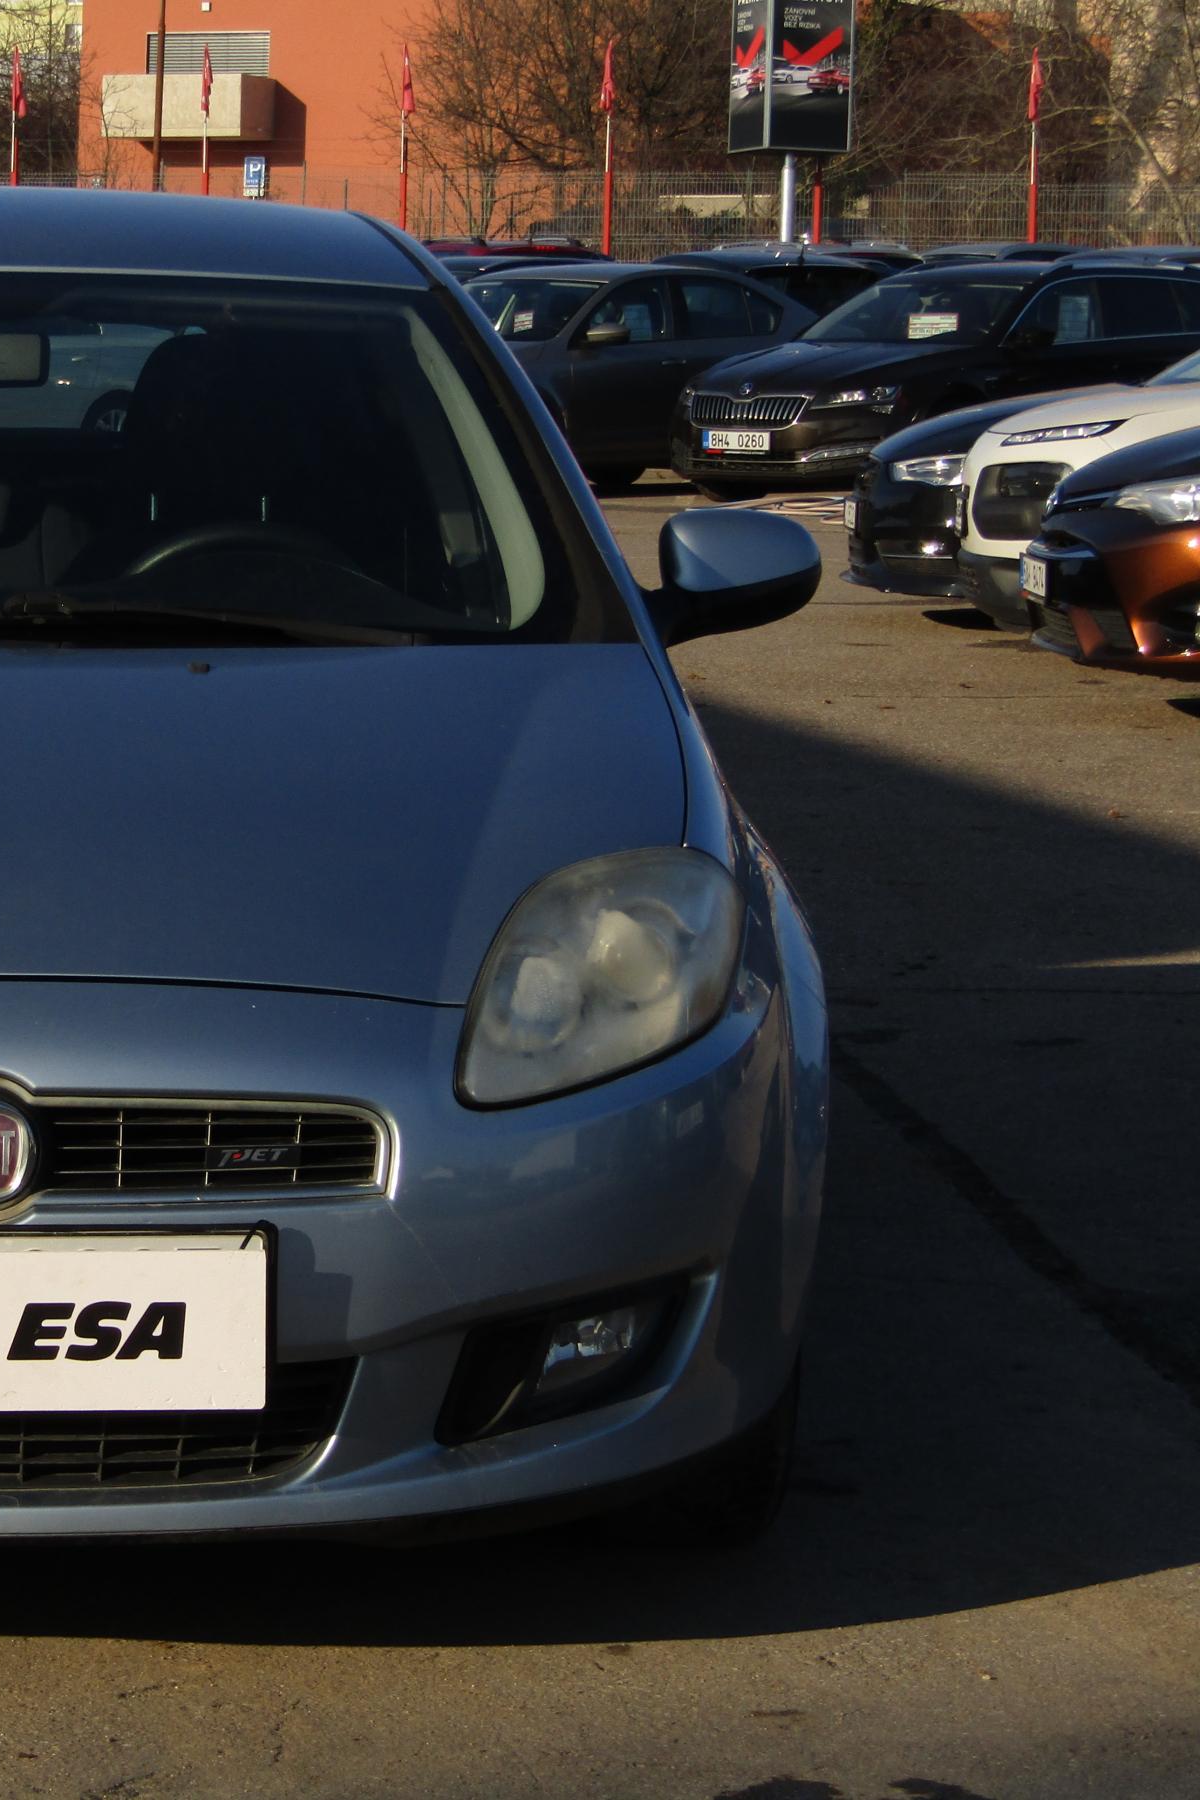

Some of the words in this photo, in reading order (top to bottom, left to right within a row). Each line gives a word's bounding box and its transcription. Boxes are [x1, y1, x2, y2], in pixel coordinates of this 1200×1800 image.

[249, 161, 262, 178] P
[711, 433, 730, 448] 8H4
[737, 434, 764, 448] 0260
[6, 1301, 187, 1362] ESA
